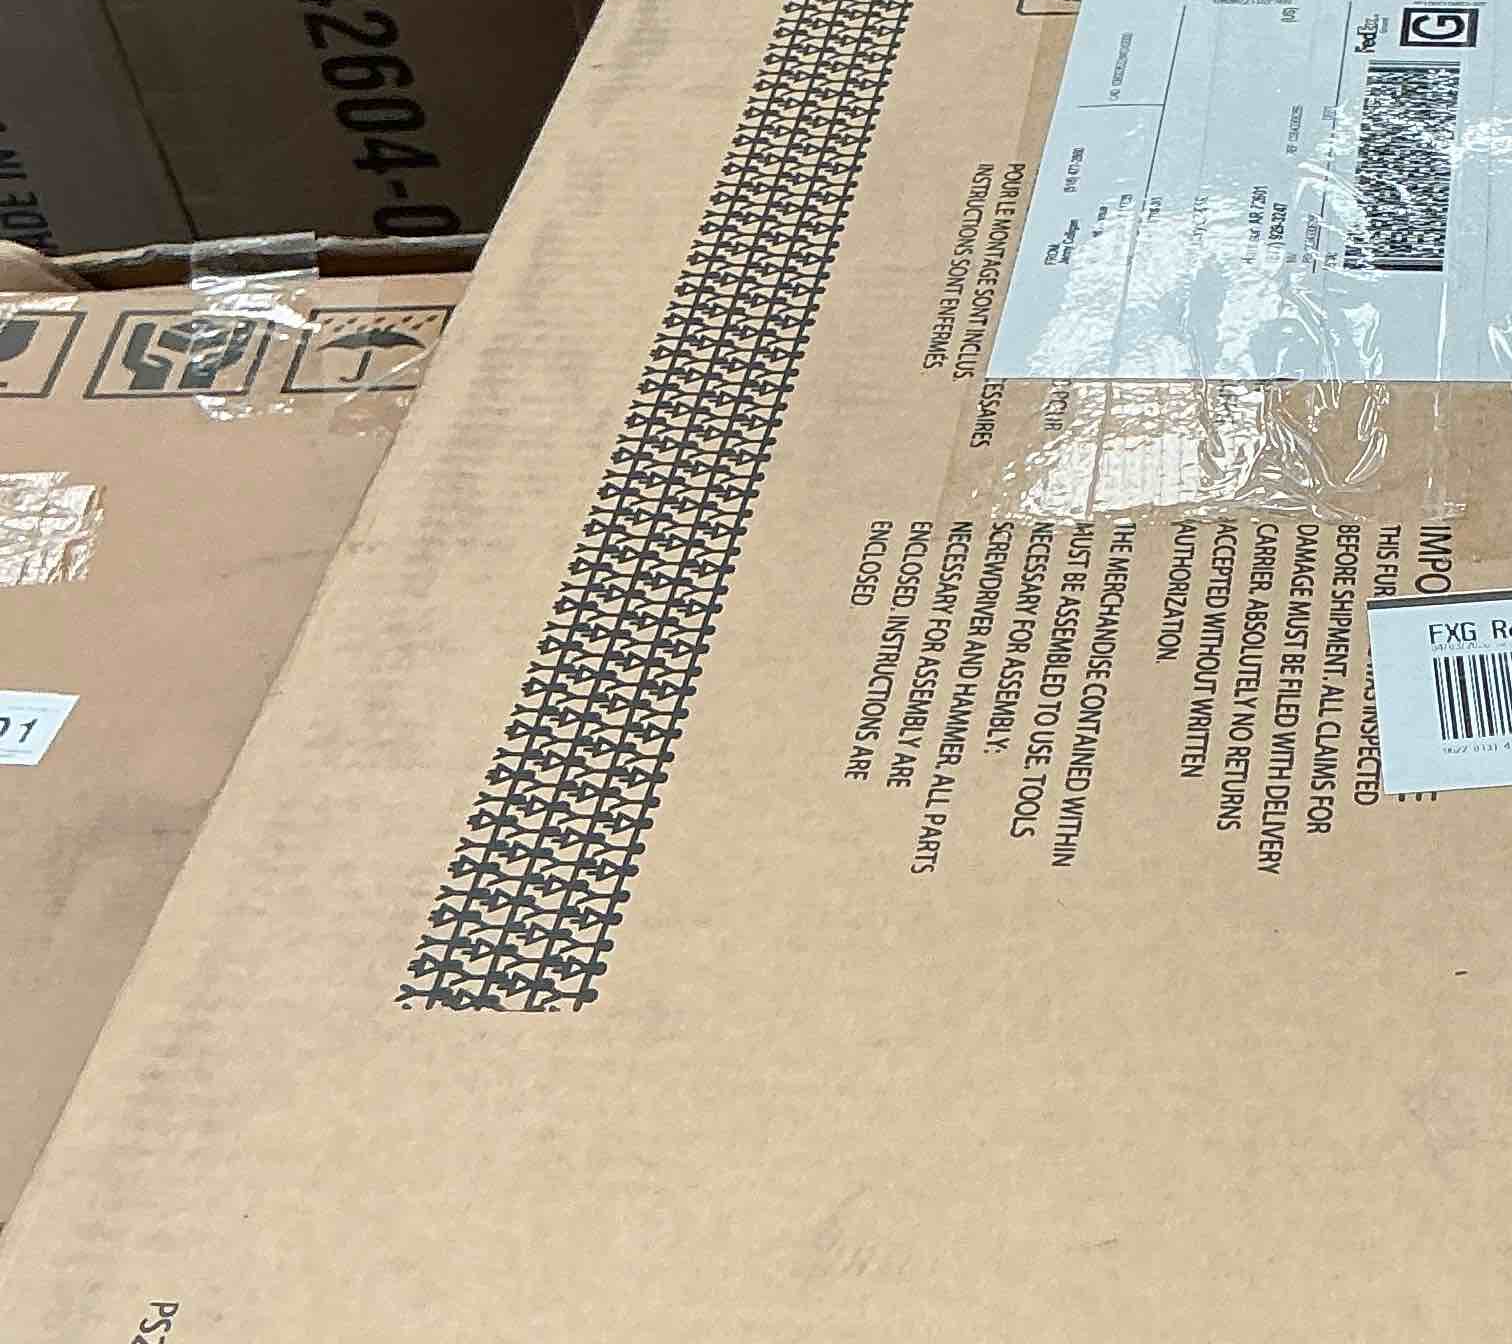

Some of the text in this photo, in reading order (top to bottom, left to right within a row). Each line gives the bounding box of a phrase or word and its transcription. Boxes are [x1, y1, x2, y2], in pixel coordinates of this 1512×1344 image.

[1411, 12, 1465, 42] G
[943, 258, 971, 296] SONT
[952, 163, 1027, 383] POUR LE MONTAGE SONT INCLUS.
[953, 163, 995, 256] INSTRUCTIONS
[983, 521, 1056, 754] NECESSARY FOR ASSEMBLY:
[1155, 521, 1198, 664] AUTHORIZATION.
[1180, 521, 1240, 778] ACCEPTED WITHOUT WRITTEN
[1375, 524, 1402, 560] THIS
[1428, 621, 1478, 648] FXG
[910, 521, 1015, 874] SCREWDRIVER AND HAMMER. ALL PARTS
[1009, 522, 1096, 839] MUST BE ASSEMBLED TO USE. TOOLS
[1050, 522, 1137, 867] THE MERCHANDISE CONTAINED WITHIN
[1216, 521, 1280, 831] CARRIER. ABSOLUTELY NO RETURNS
[1256, 524, 1320, 875] DAMAGE MUST BE FILED WITH DELIVERY
[1305, 524, 1361, 834] BEFORE SHIPMENT. ALL CLAIMS FOR
